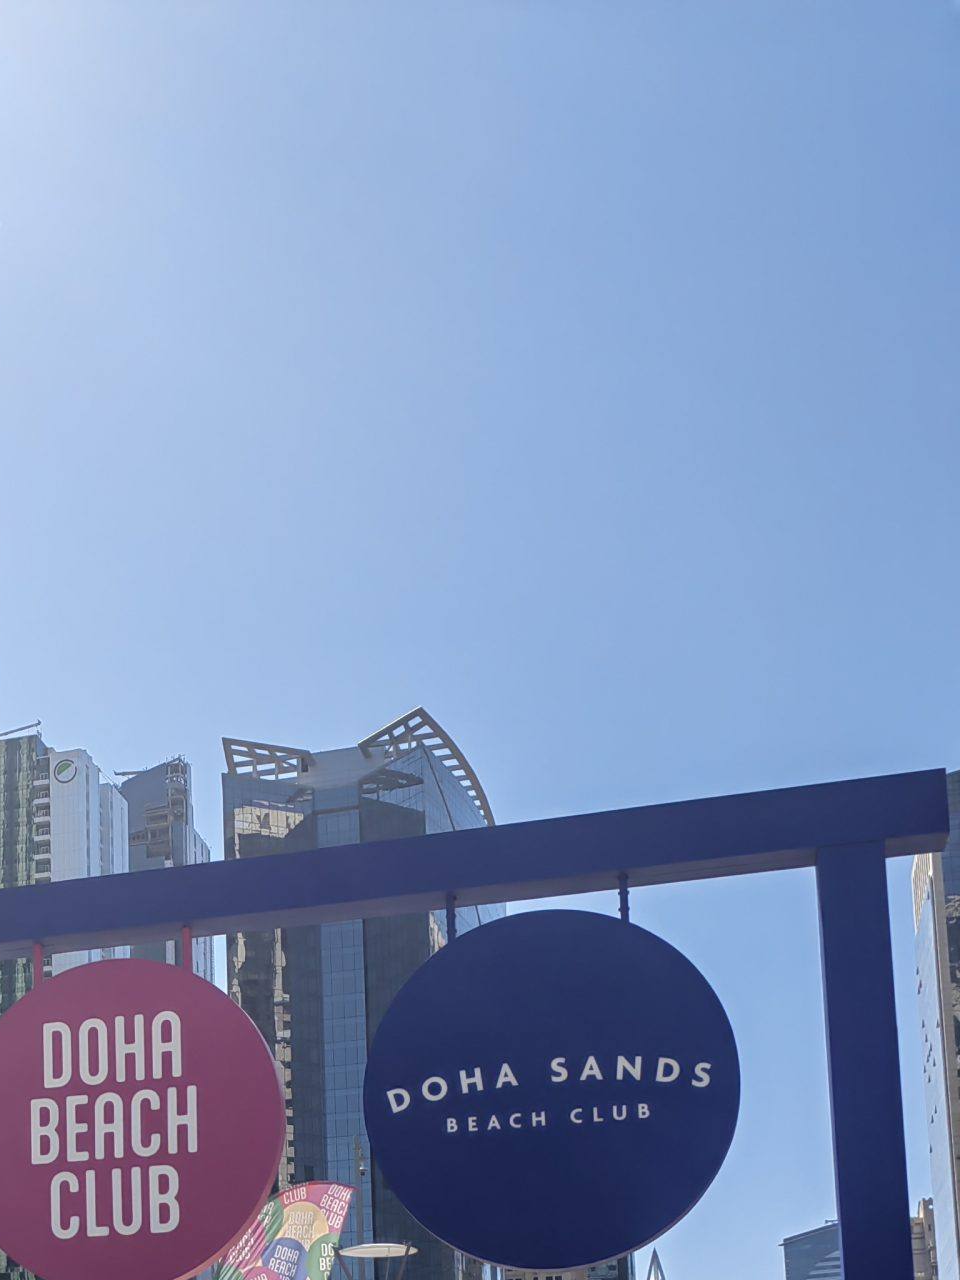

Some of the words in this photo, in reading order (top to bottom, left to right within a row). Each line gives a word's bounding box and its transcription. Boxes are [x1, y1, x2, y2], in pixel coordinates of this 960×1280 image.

[43, 1011, 181, 1089] DOHA
[387, 1062, 518, 1114] DOHA
[551, 1055, 713, 1088] SANDS
[30, 1085, 198, 1166] BEACH
[446, 1110, 547, 1134] BEACH
[570, 1103, 651, 1124] CLUB
[51, 1164, 181, 1240] CLUB
[283, 1187, 307, 1204] CLUB
[289, 1211, 314, 1225] DOHA
[269, 1258, 297, 1278] BEACH
[274, 1245, 299, 1263] DOHA
